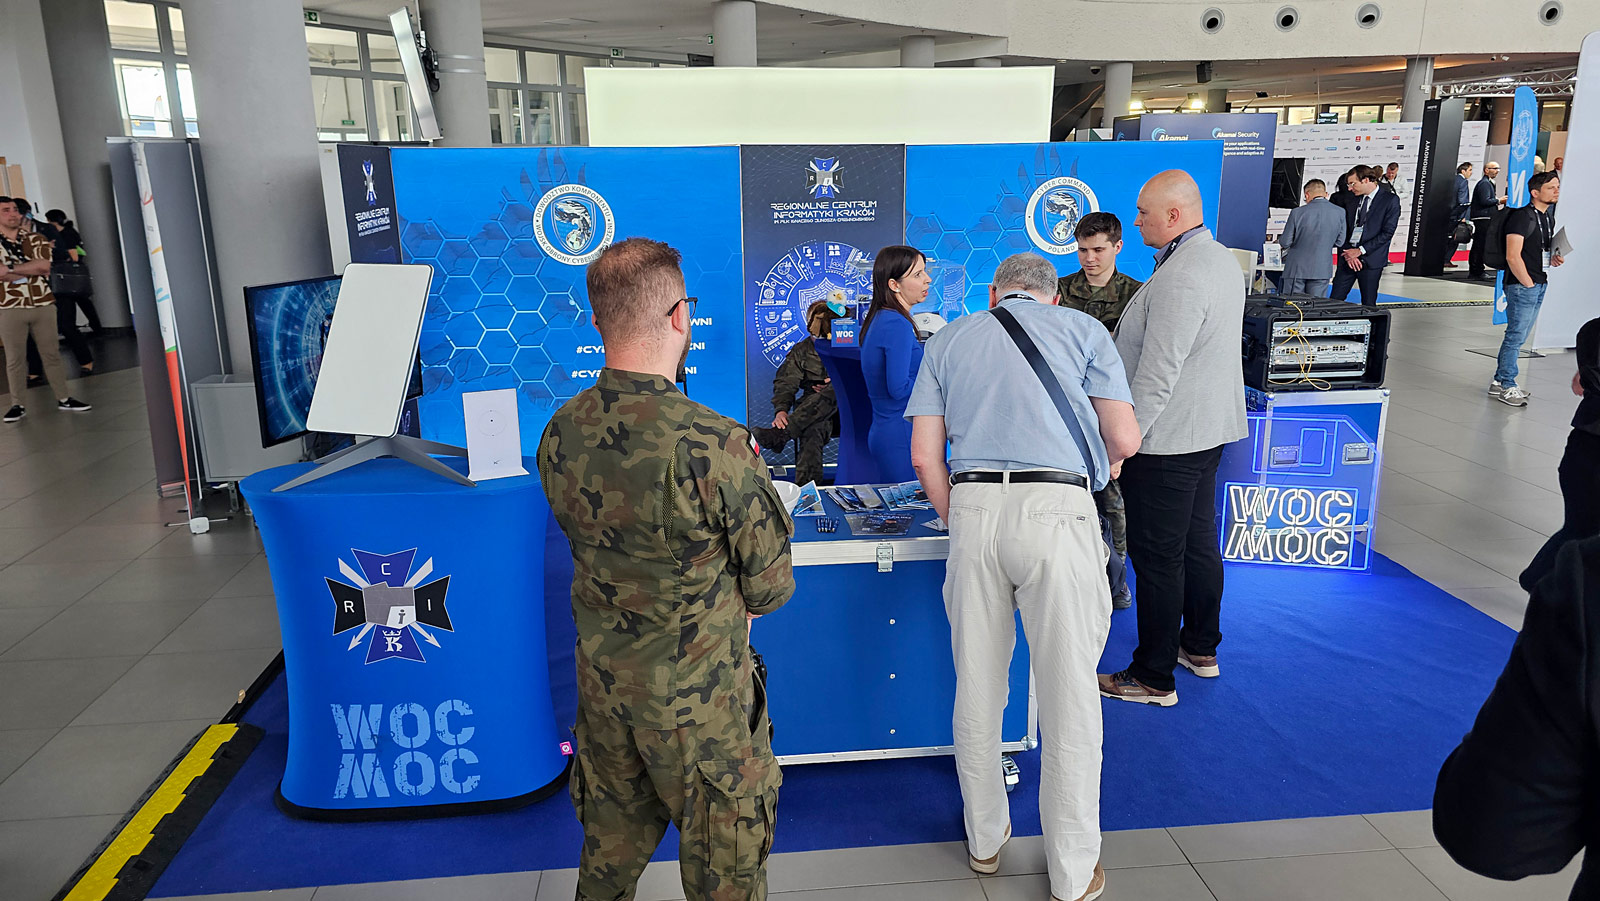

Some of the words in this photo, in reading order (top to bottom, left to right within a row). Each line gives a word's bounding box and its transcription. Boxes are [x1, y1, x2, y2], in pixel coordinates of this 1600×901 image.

[1419, 140, 1431, 194] ANTYDRONOWY
[1037, 182, 1056, 196] CYBER
[1058, 179, 1091, 195] COMMAND
[572, 186, 611, 217] KOMPONENTU
[770, 201, 829, 211] REGIONALNE
[832, 200, 877, 209] CENTRUM
[773, 210, 833, 219] INFORMATYKI
[836, 207, 875, 217] KRAKÓW
[1415, 194, 1424, 222] SYSTEM
[536, 224, 548, 247] WOJSK
[546, 246, 570, 262] OBRONY
[1412, 222, 1420, 248] POLSKI
[1047, 245, 1076, 254] POLAND
[1229, 485, 1353, 527] WOC
[381, 562, 392, 576] C
[343, 600, 355, 614] R
[330, 699, 475, 750] WOC
